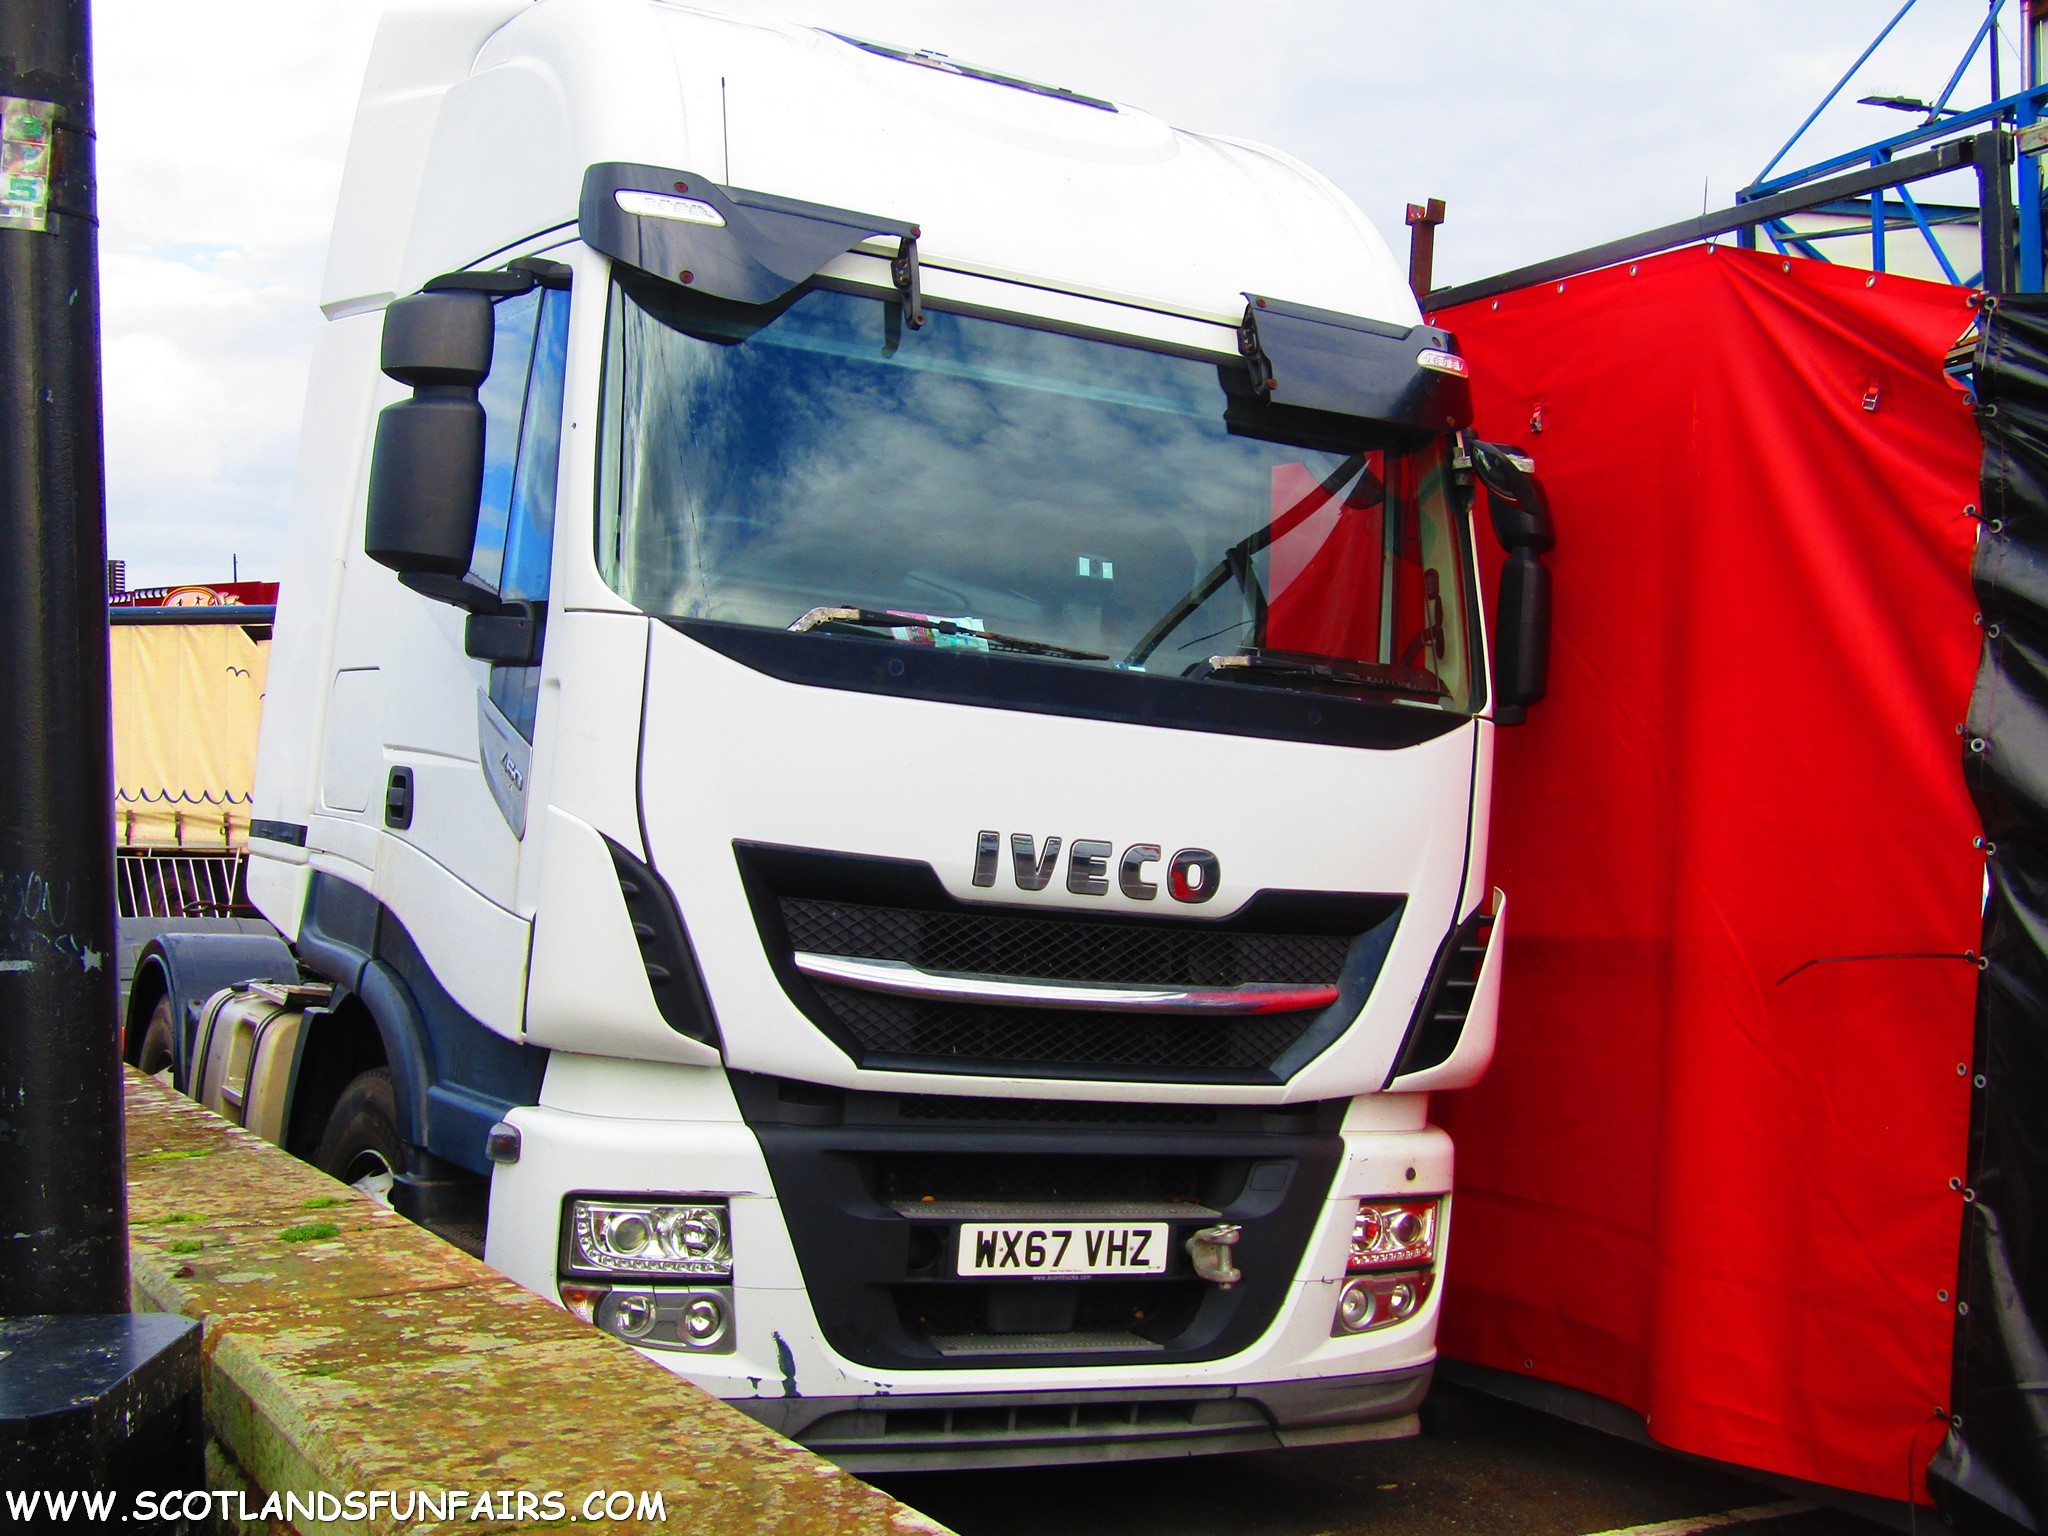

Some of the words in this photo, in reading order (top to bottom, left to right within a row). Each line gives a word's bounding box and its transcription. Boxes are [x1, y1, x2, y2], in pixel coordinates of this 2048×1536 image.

[971, 829, 1221, 904] IVECO
[975, 1230, 1073, 1268] WX67
[1085, 1229, 1152, 1267] VHZ
